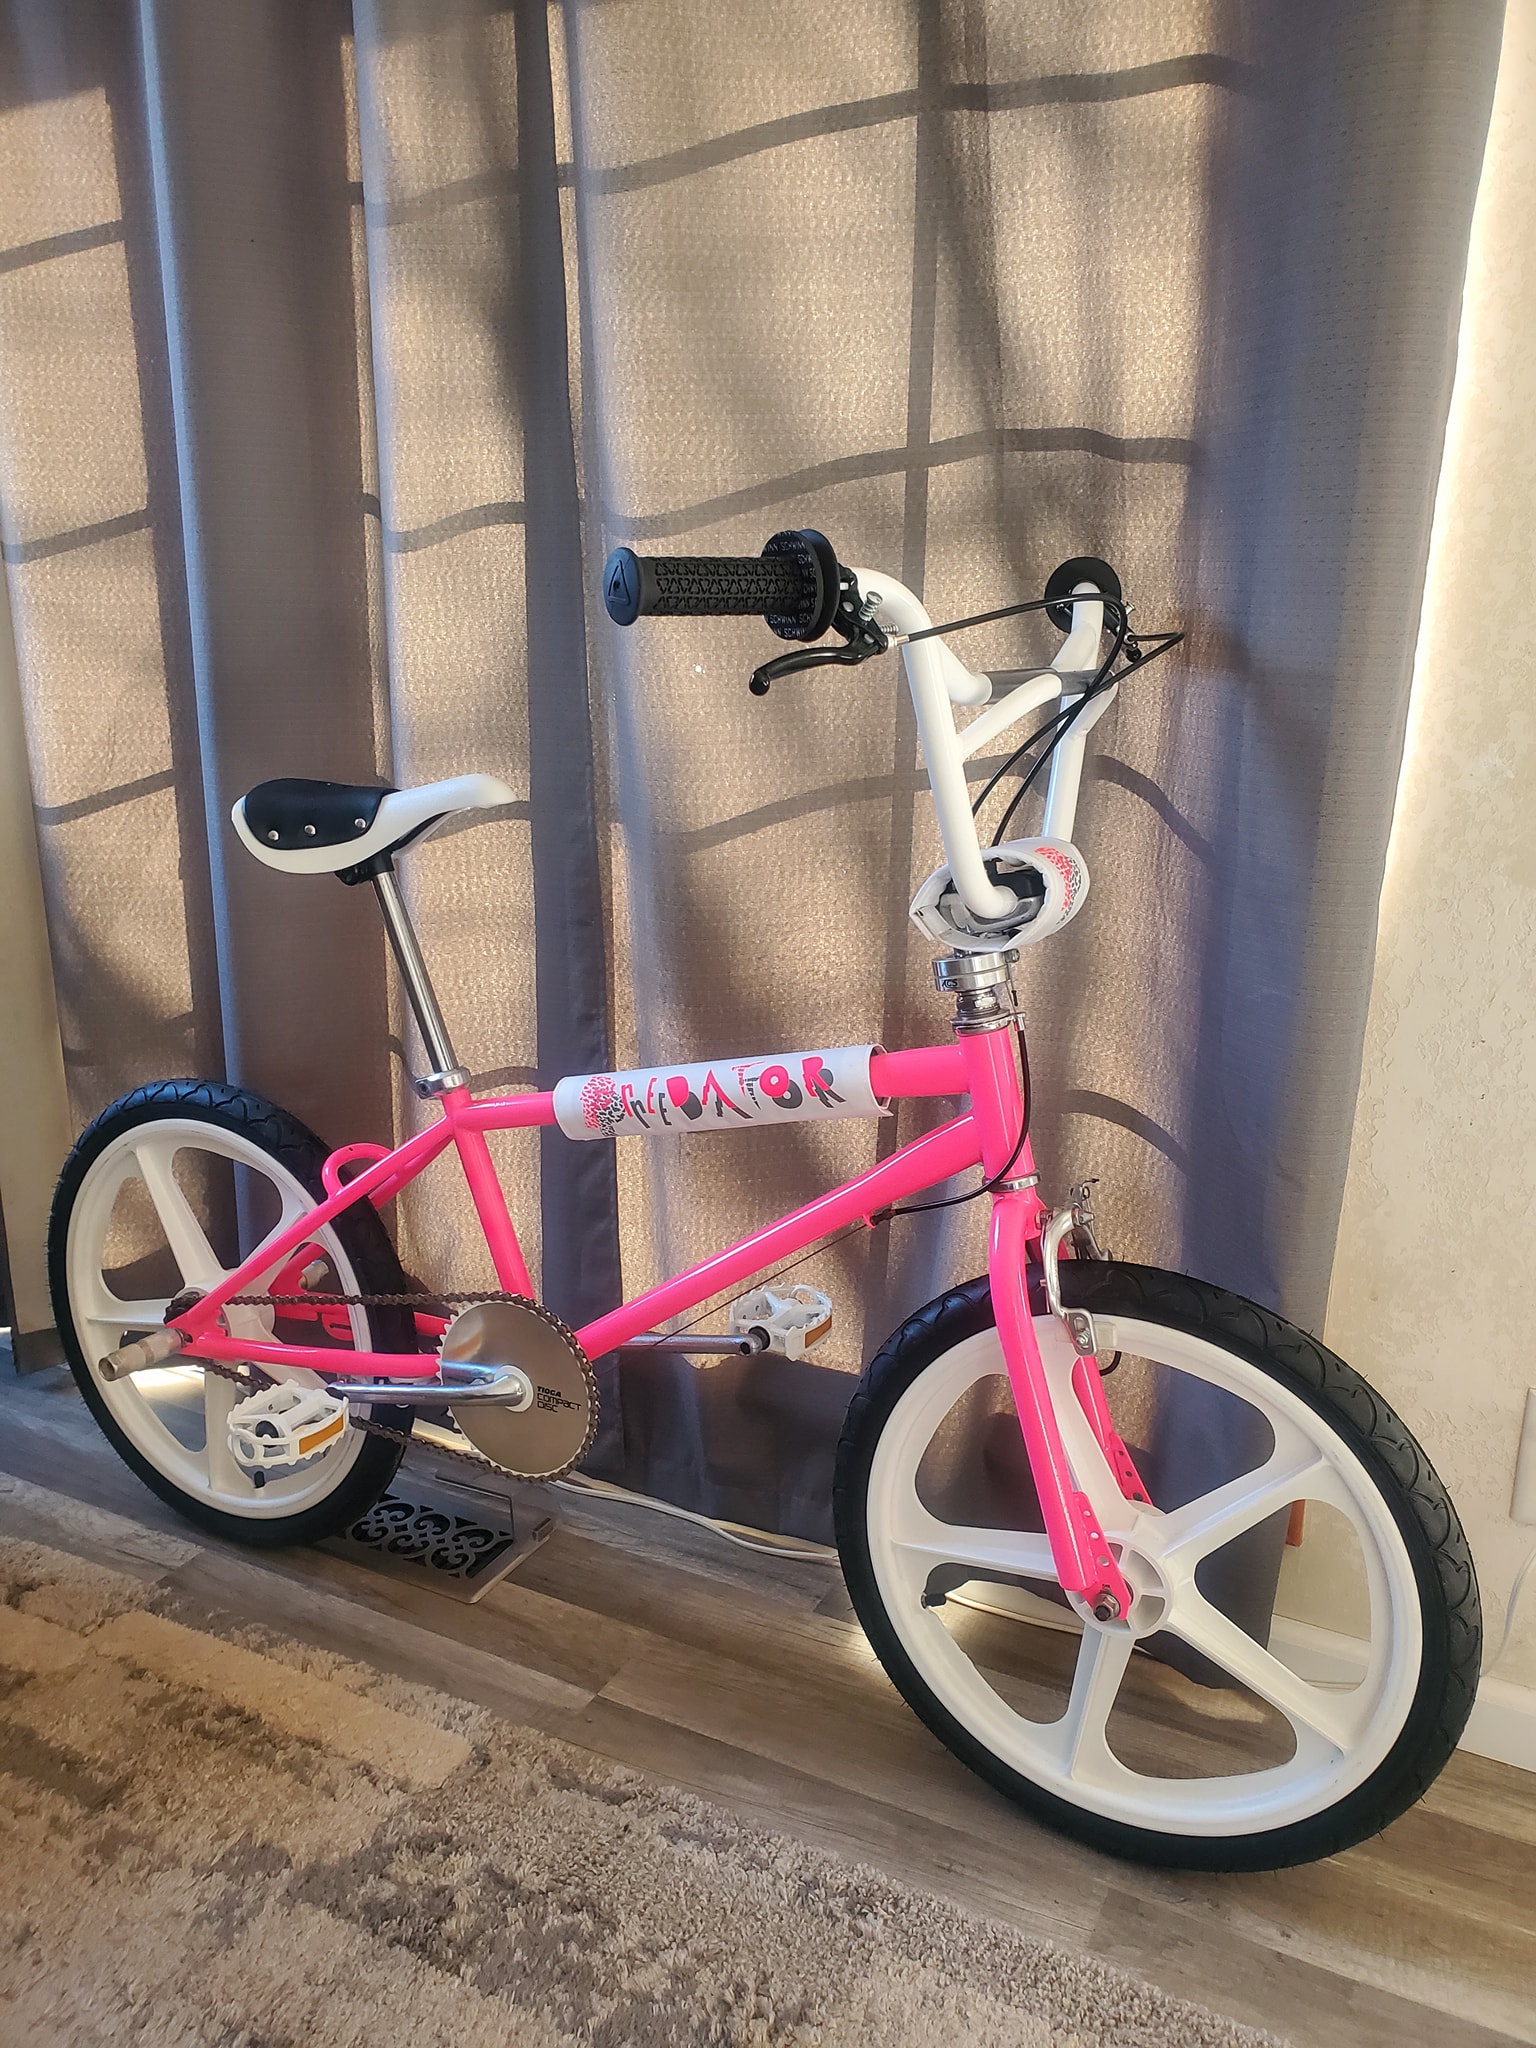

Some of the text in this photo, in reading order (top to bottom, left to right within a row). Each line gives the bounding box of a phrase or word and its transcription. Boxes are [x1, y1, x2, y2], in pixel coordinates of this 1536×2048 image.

[537, 1386, 562, 1398] TIOGA
[537, 1393, 581, 1411] COMPACT
[537, 1401, 559, 1413] DISC
